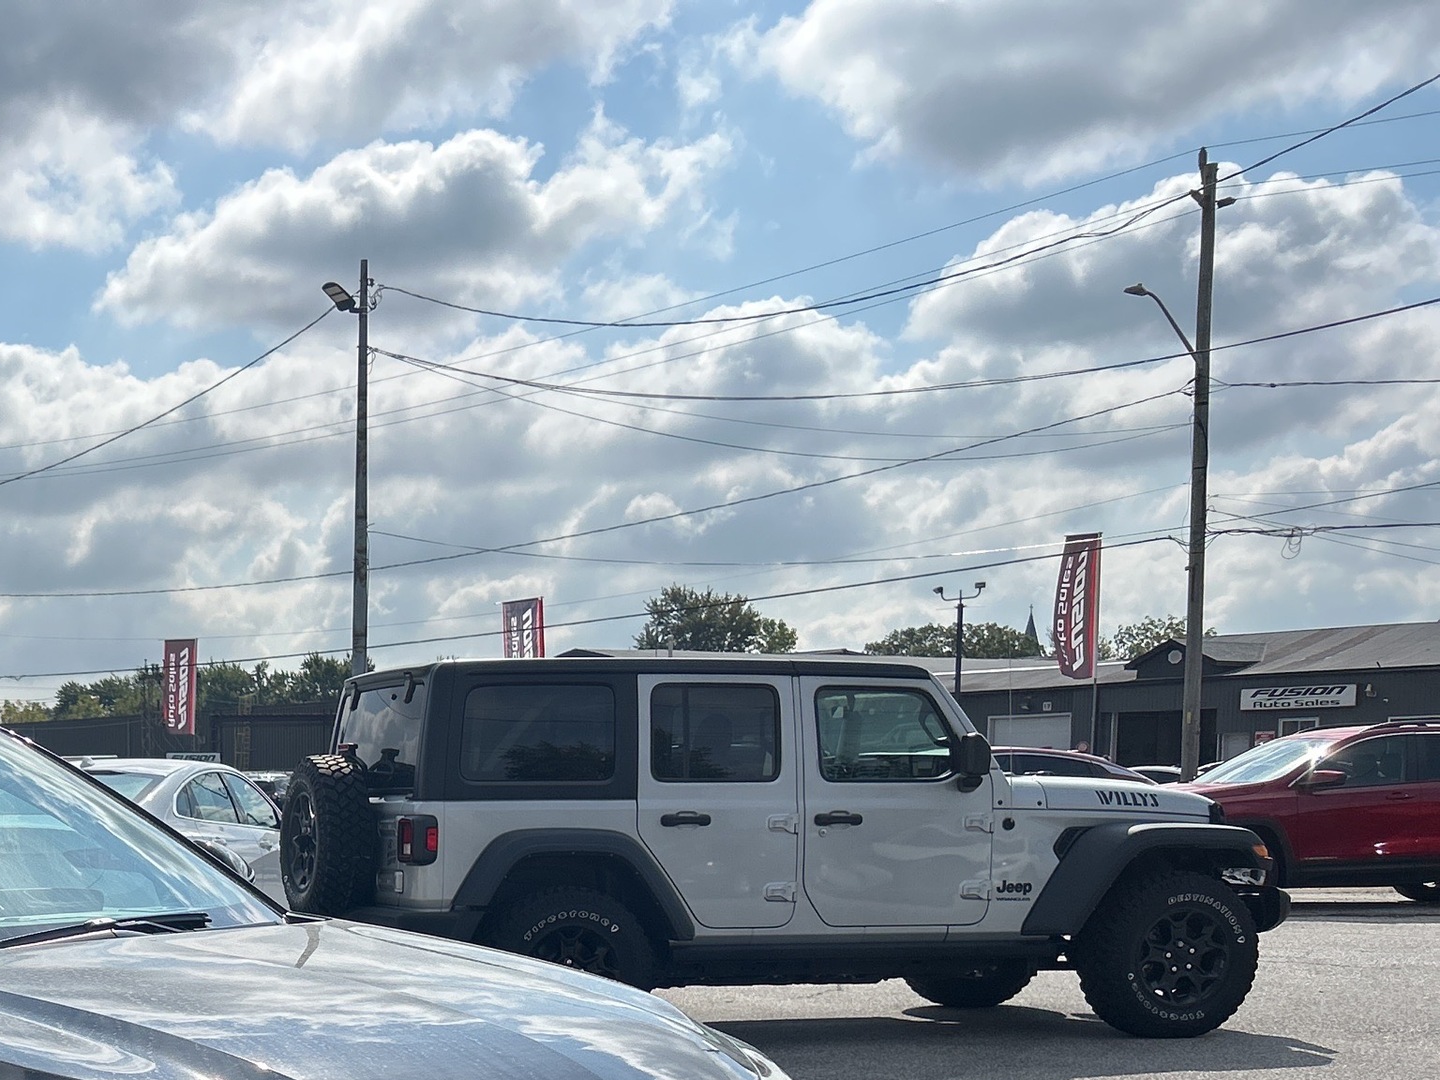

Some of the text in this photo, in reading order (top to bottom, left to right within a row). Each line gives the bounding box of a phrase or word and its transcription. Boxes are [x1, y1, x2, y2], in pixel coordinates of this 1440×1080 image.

[1250, 685, 1348, 699] FUSION
[1253, 699, 1340, 709] Auto Sales
[1095, 790, 1159, 807] WILLYS
[996, 880, 1032, 896] Jeep
[1167, 893, 1243, 935] DESTINATION
[523, 910, 610, 942] Firestone
